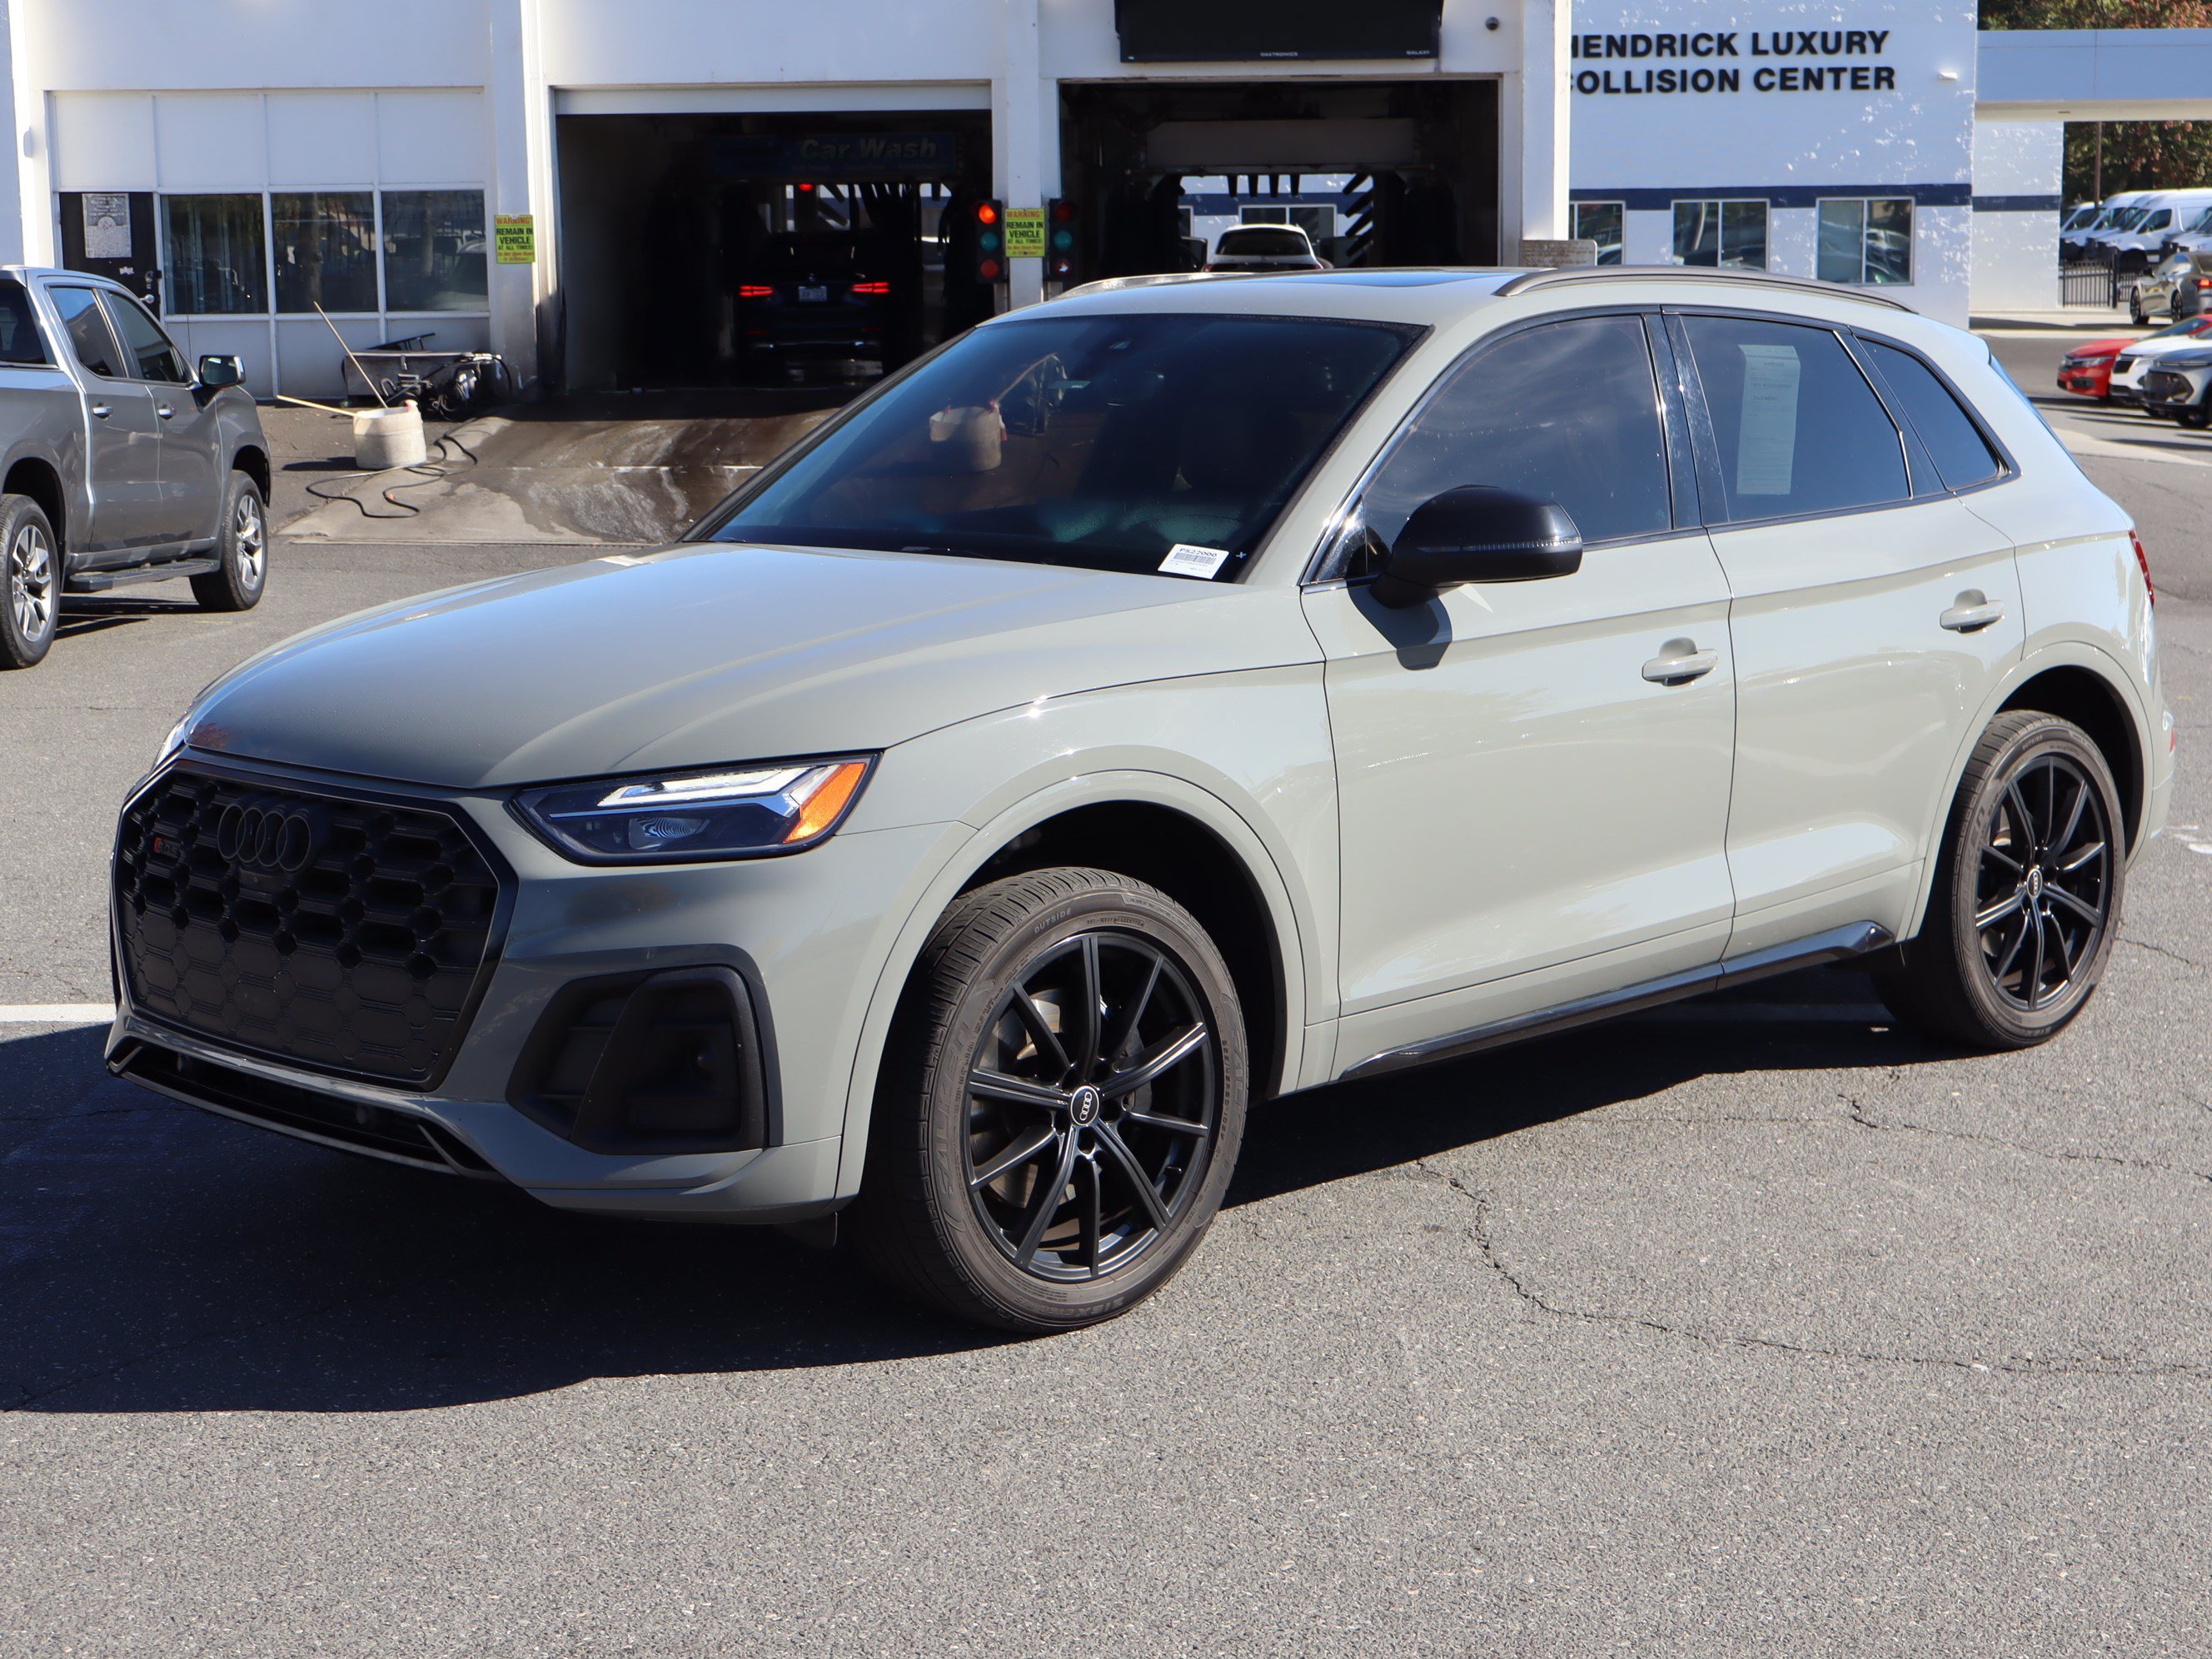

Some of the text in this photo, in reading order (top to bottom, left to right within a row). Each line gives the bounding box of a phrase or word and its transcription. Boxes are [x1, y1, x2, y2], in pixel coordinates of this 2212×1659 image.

[1751, 31, 1889, 55] LUXURY
[1571, 67, 1895, 94] OLLISION CENTER
[800, 137, 938, 160] Car Wash
[1009, 230, 1040, 238] VEHICLE
[1034, 908, 1072, 933] OUTSIDE
